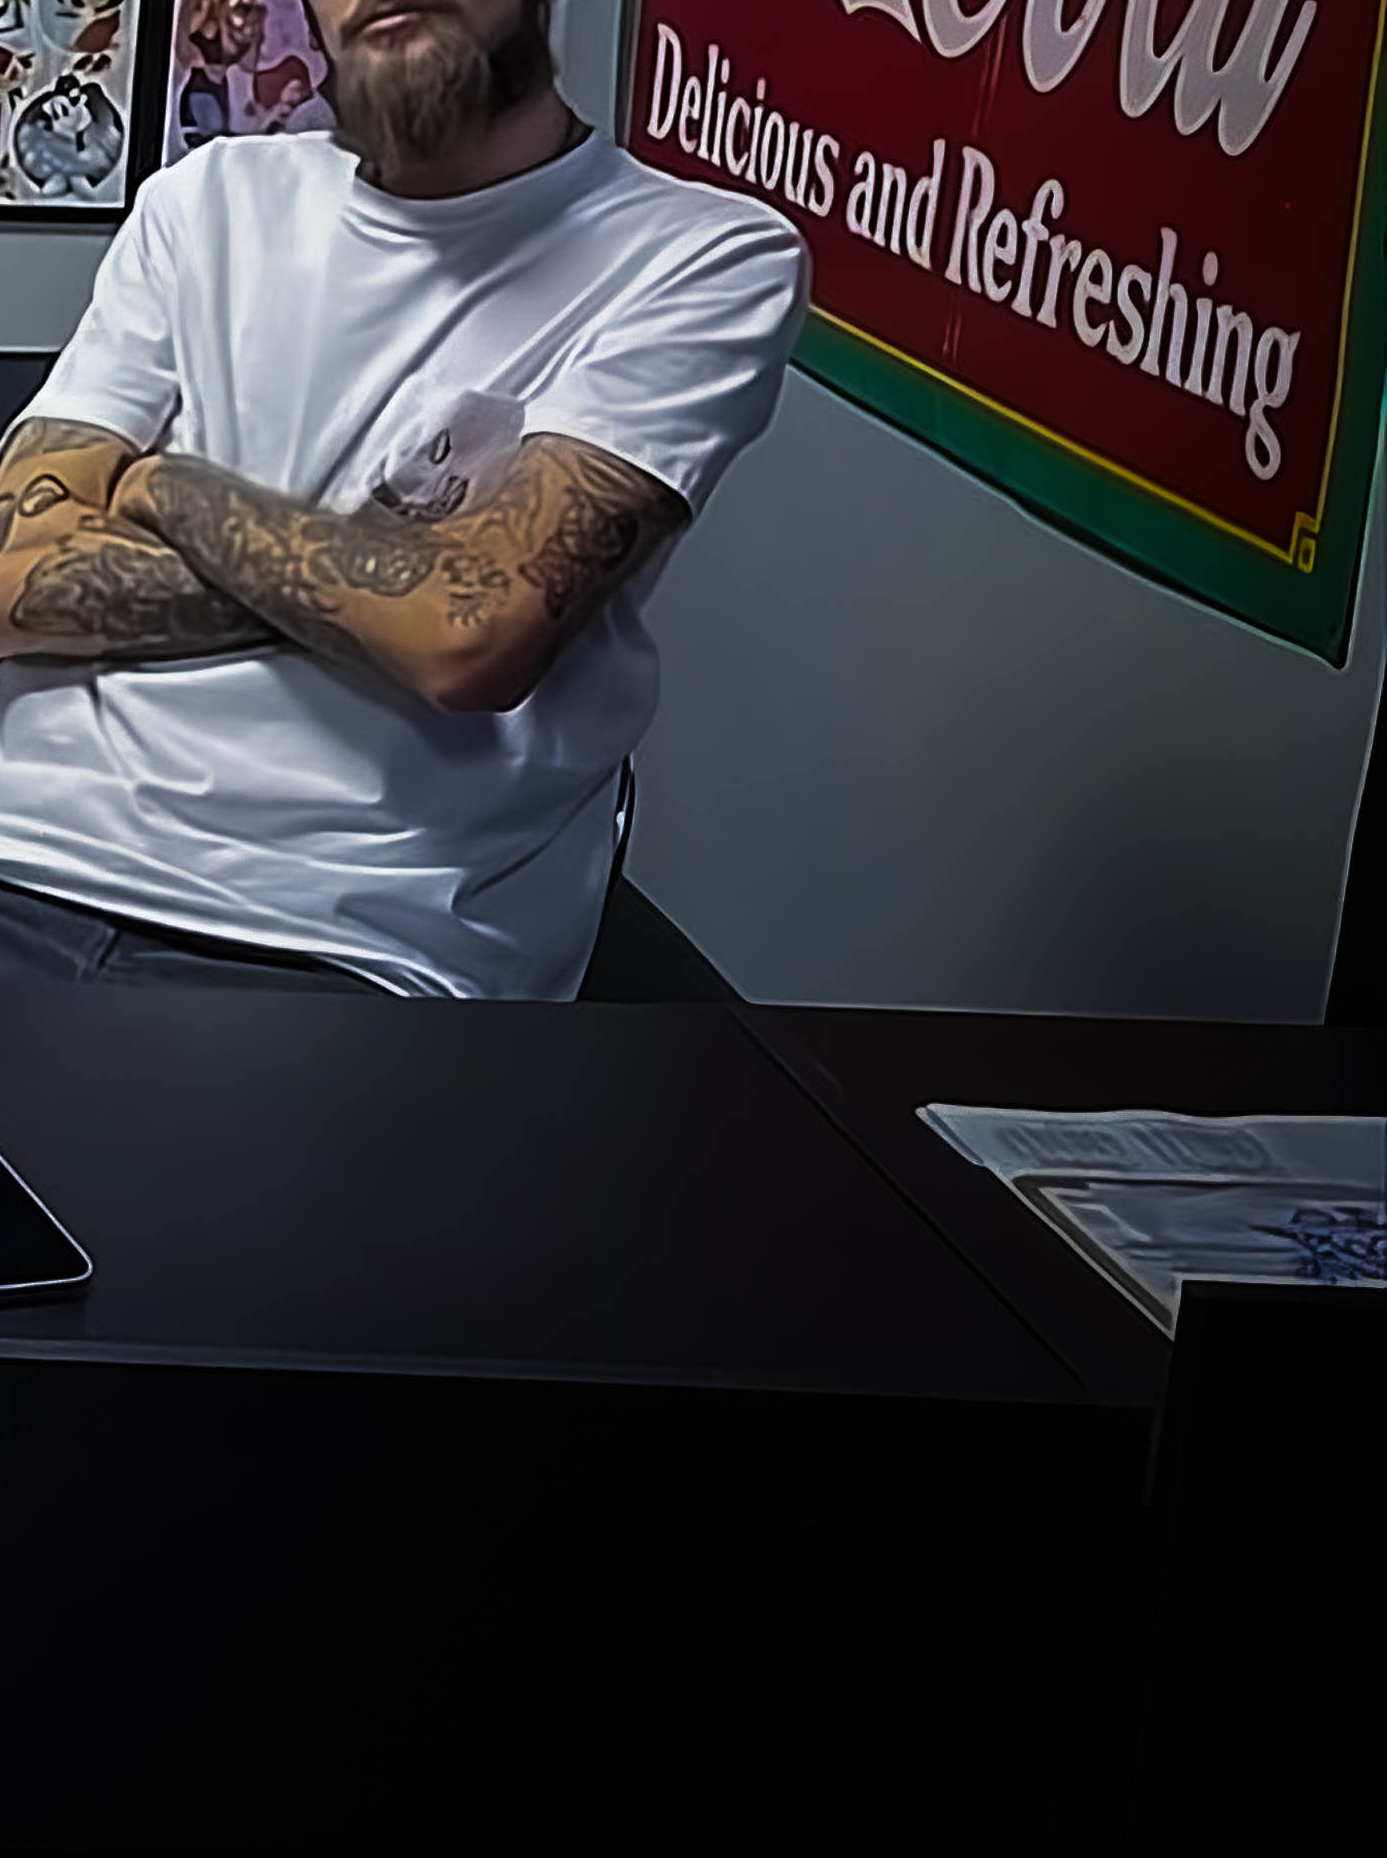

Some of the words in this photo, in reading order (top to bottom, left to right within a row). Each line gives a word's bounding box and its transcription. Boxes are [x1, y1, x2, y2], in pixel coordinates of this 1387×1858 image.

[646, 22, 840, 218] Delicious
[845, 138, 948, 270] and
[944, 146, 1301, 481] Refreshing
